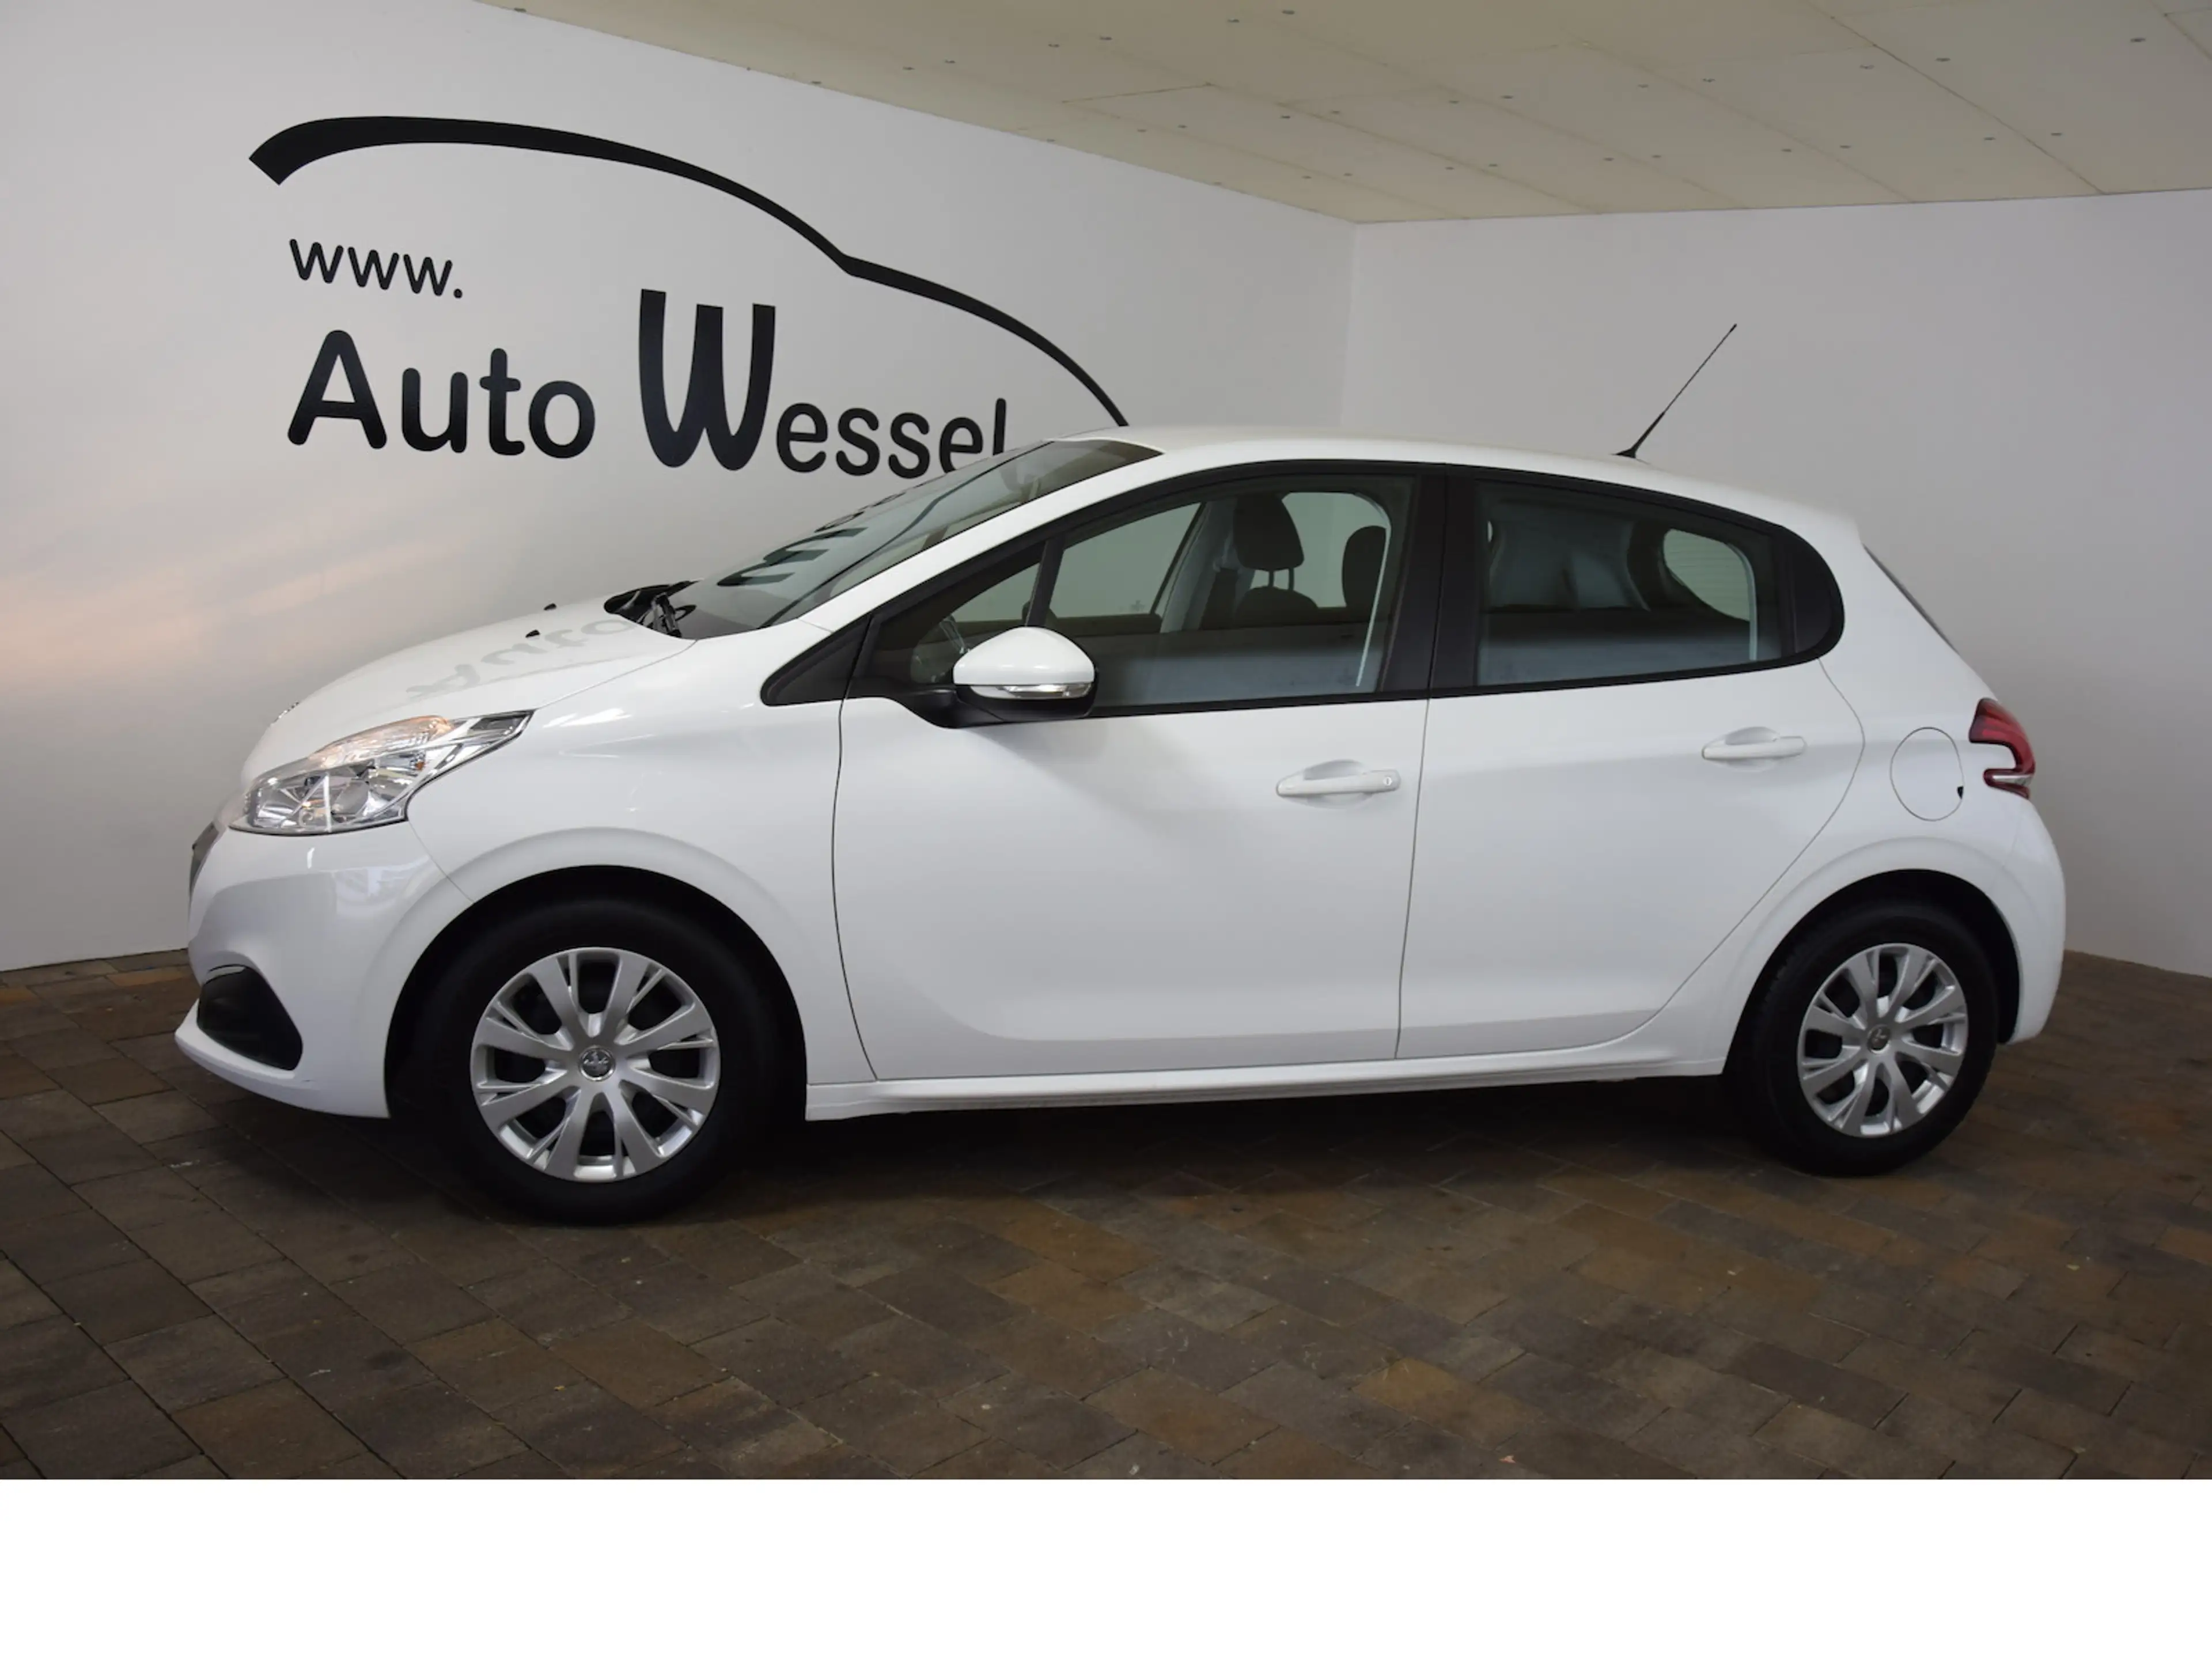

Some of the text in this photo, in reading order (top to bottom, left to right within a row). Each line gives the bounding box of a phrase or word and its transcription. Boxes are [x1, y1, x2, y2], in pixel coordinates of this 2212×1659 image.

[289, 238, 463, 298] www.
[287, 288, 1007, 480] Auto Wessel
